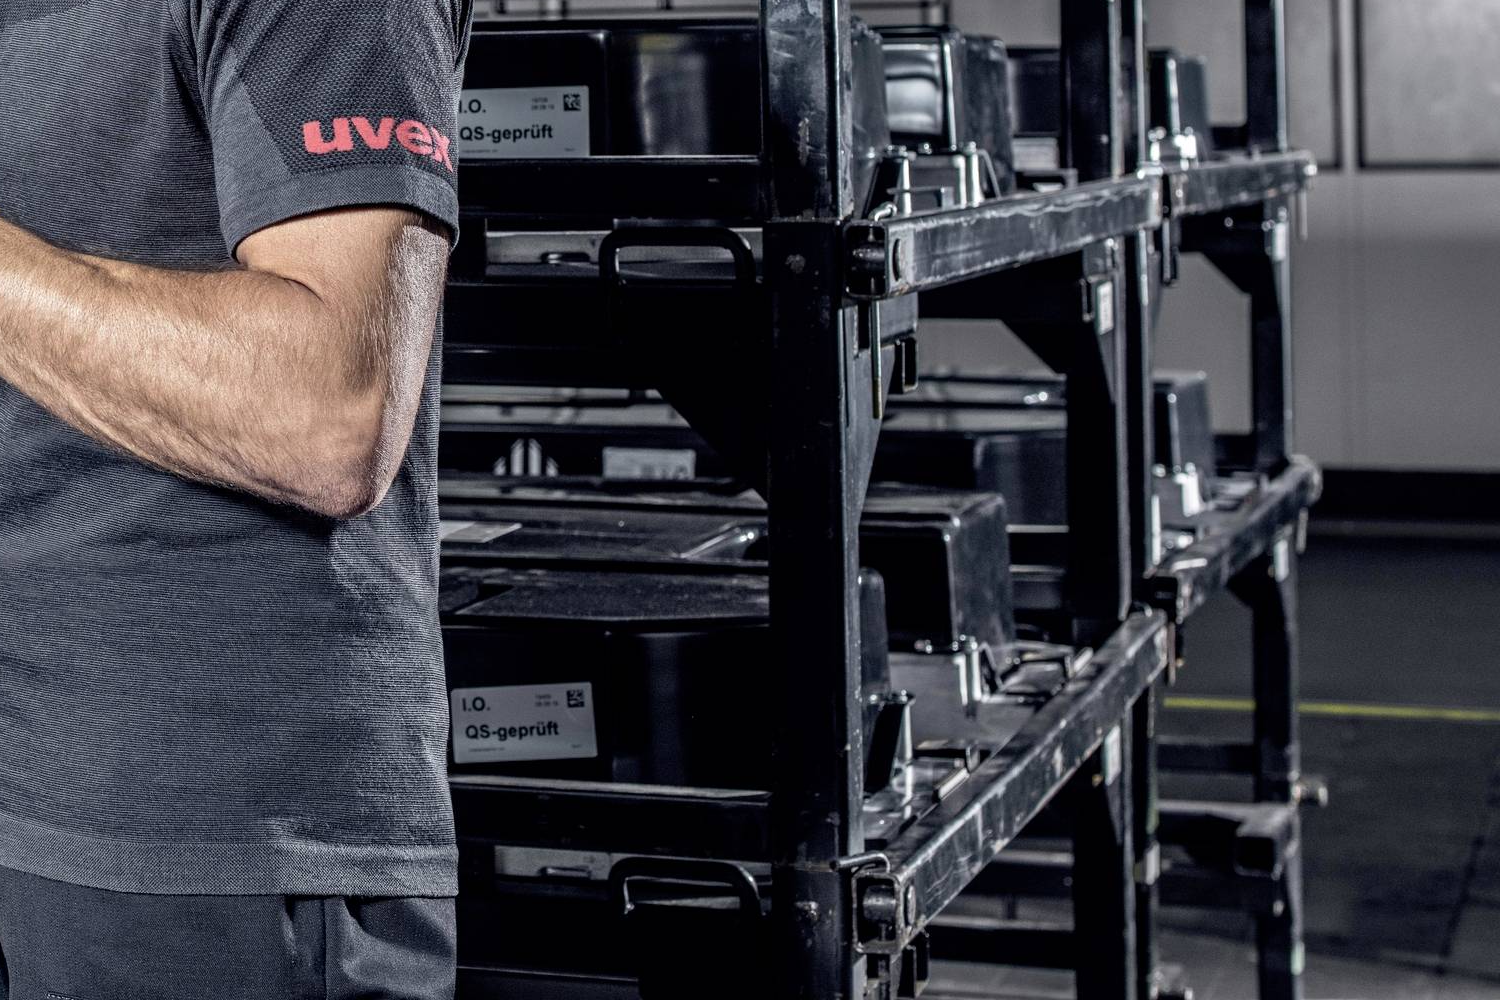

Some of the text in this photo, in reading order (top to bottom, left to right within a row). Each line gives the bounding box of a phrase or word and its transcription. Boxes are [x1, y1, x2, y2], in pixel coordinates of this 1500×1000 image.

[460, 123, 553, 143] QS-geprüft
[303, 116, 453, 172] uvex
[461, 696, 491, 712] I.O.
[465, 721, 559, 741] QS-geprüft
